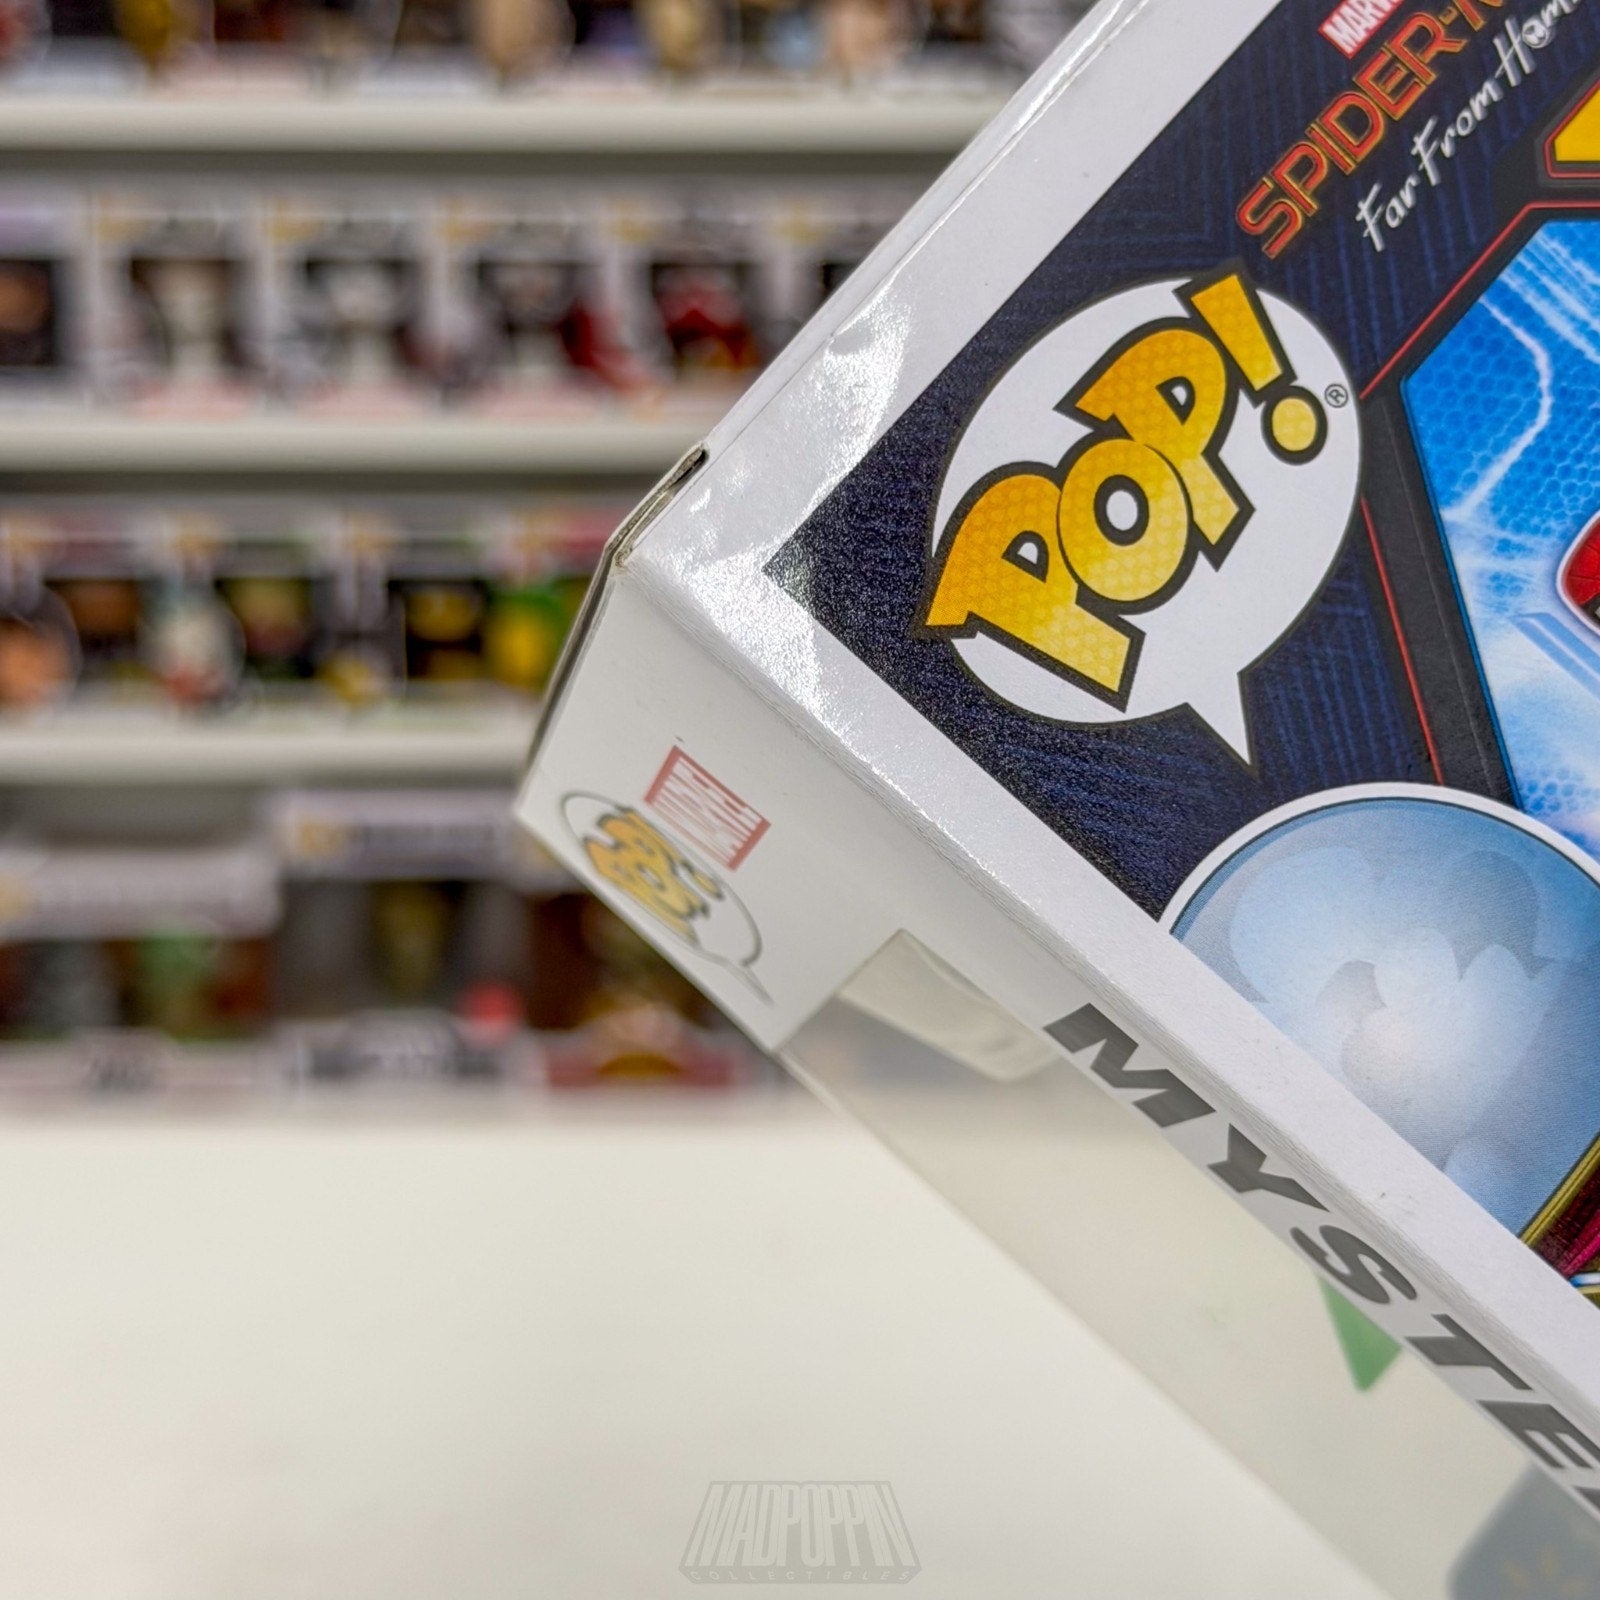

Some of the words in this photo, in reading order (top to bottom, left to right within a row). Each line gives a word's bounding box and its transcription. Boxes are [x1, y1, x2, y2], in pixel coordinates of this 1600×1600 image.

[1356, 181, 1421, 252] Far
[1411, 77, 1504, 187] From
[1492, 0, 1579, 87] Hom
[917, 265, 1327, 710] POP!
[645, 748, 769, 870] MARVEL
[1042, 1002, 1600, 1516] MYSTE
